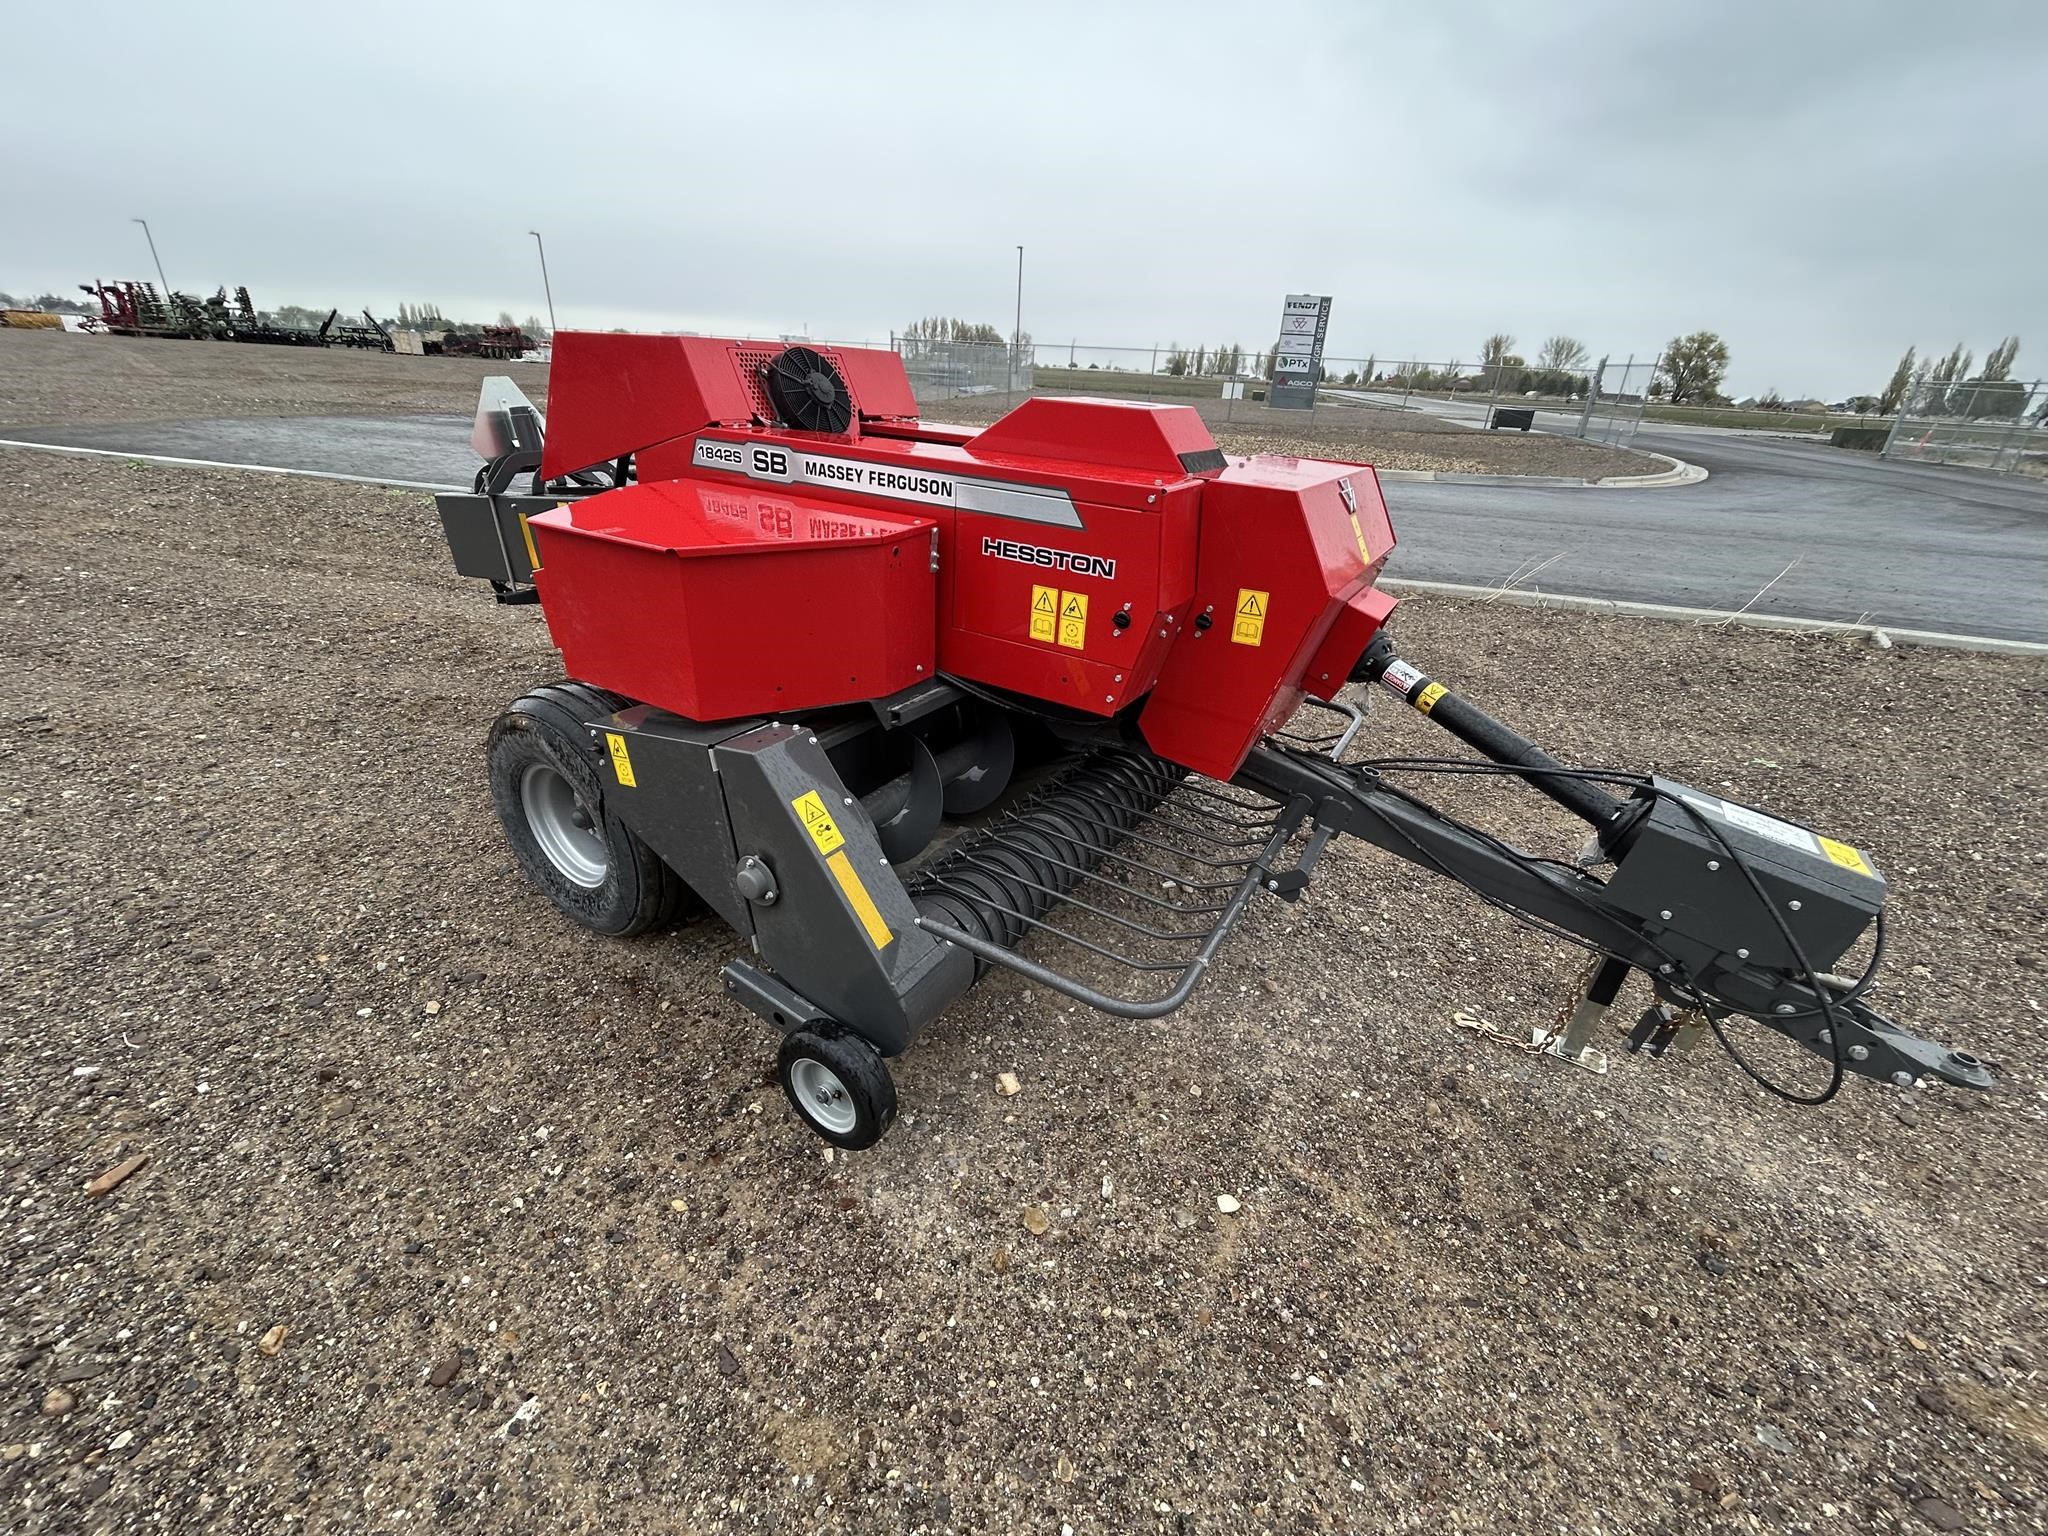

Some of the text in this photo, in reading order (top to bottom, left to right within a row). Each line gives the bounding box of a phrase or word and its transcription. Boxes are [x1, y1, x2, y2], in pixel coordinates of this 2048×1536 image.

[1313, 300, 1330, 363] AGRI-SERVICE
[1288, 359, 1308, 368] PTx
[697, 445, 953, 498] 1842S SB MASSEY FERGUSON
[983, 538, 1114, 578] HESSTON
